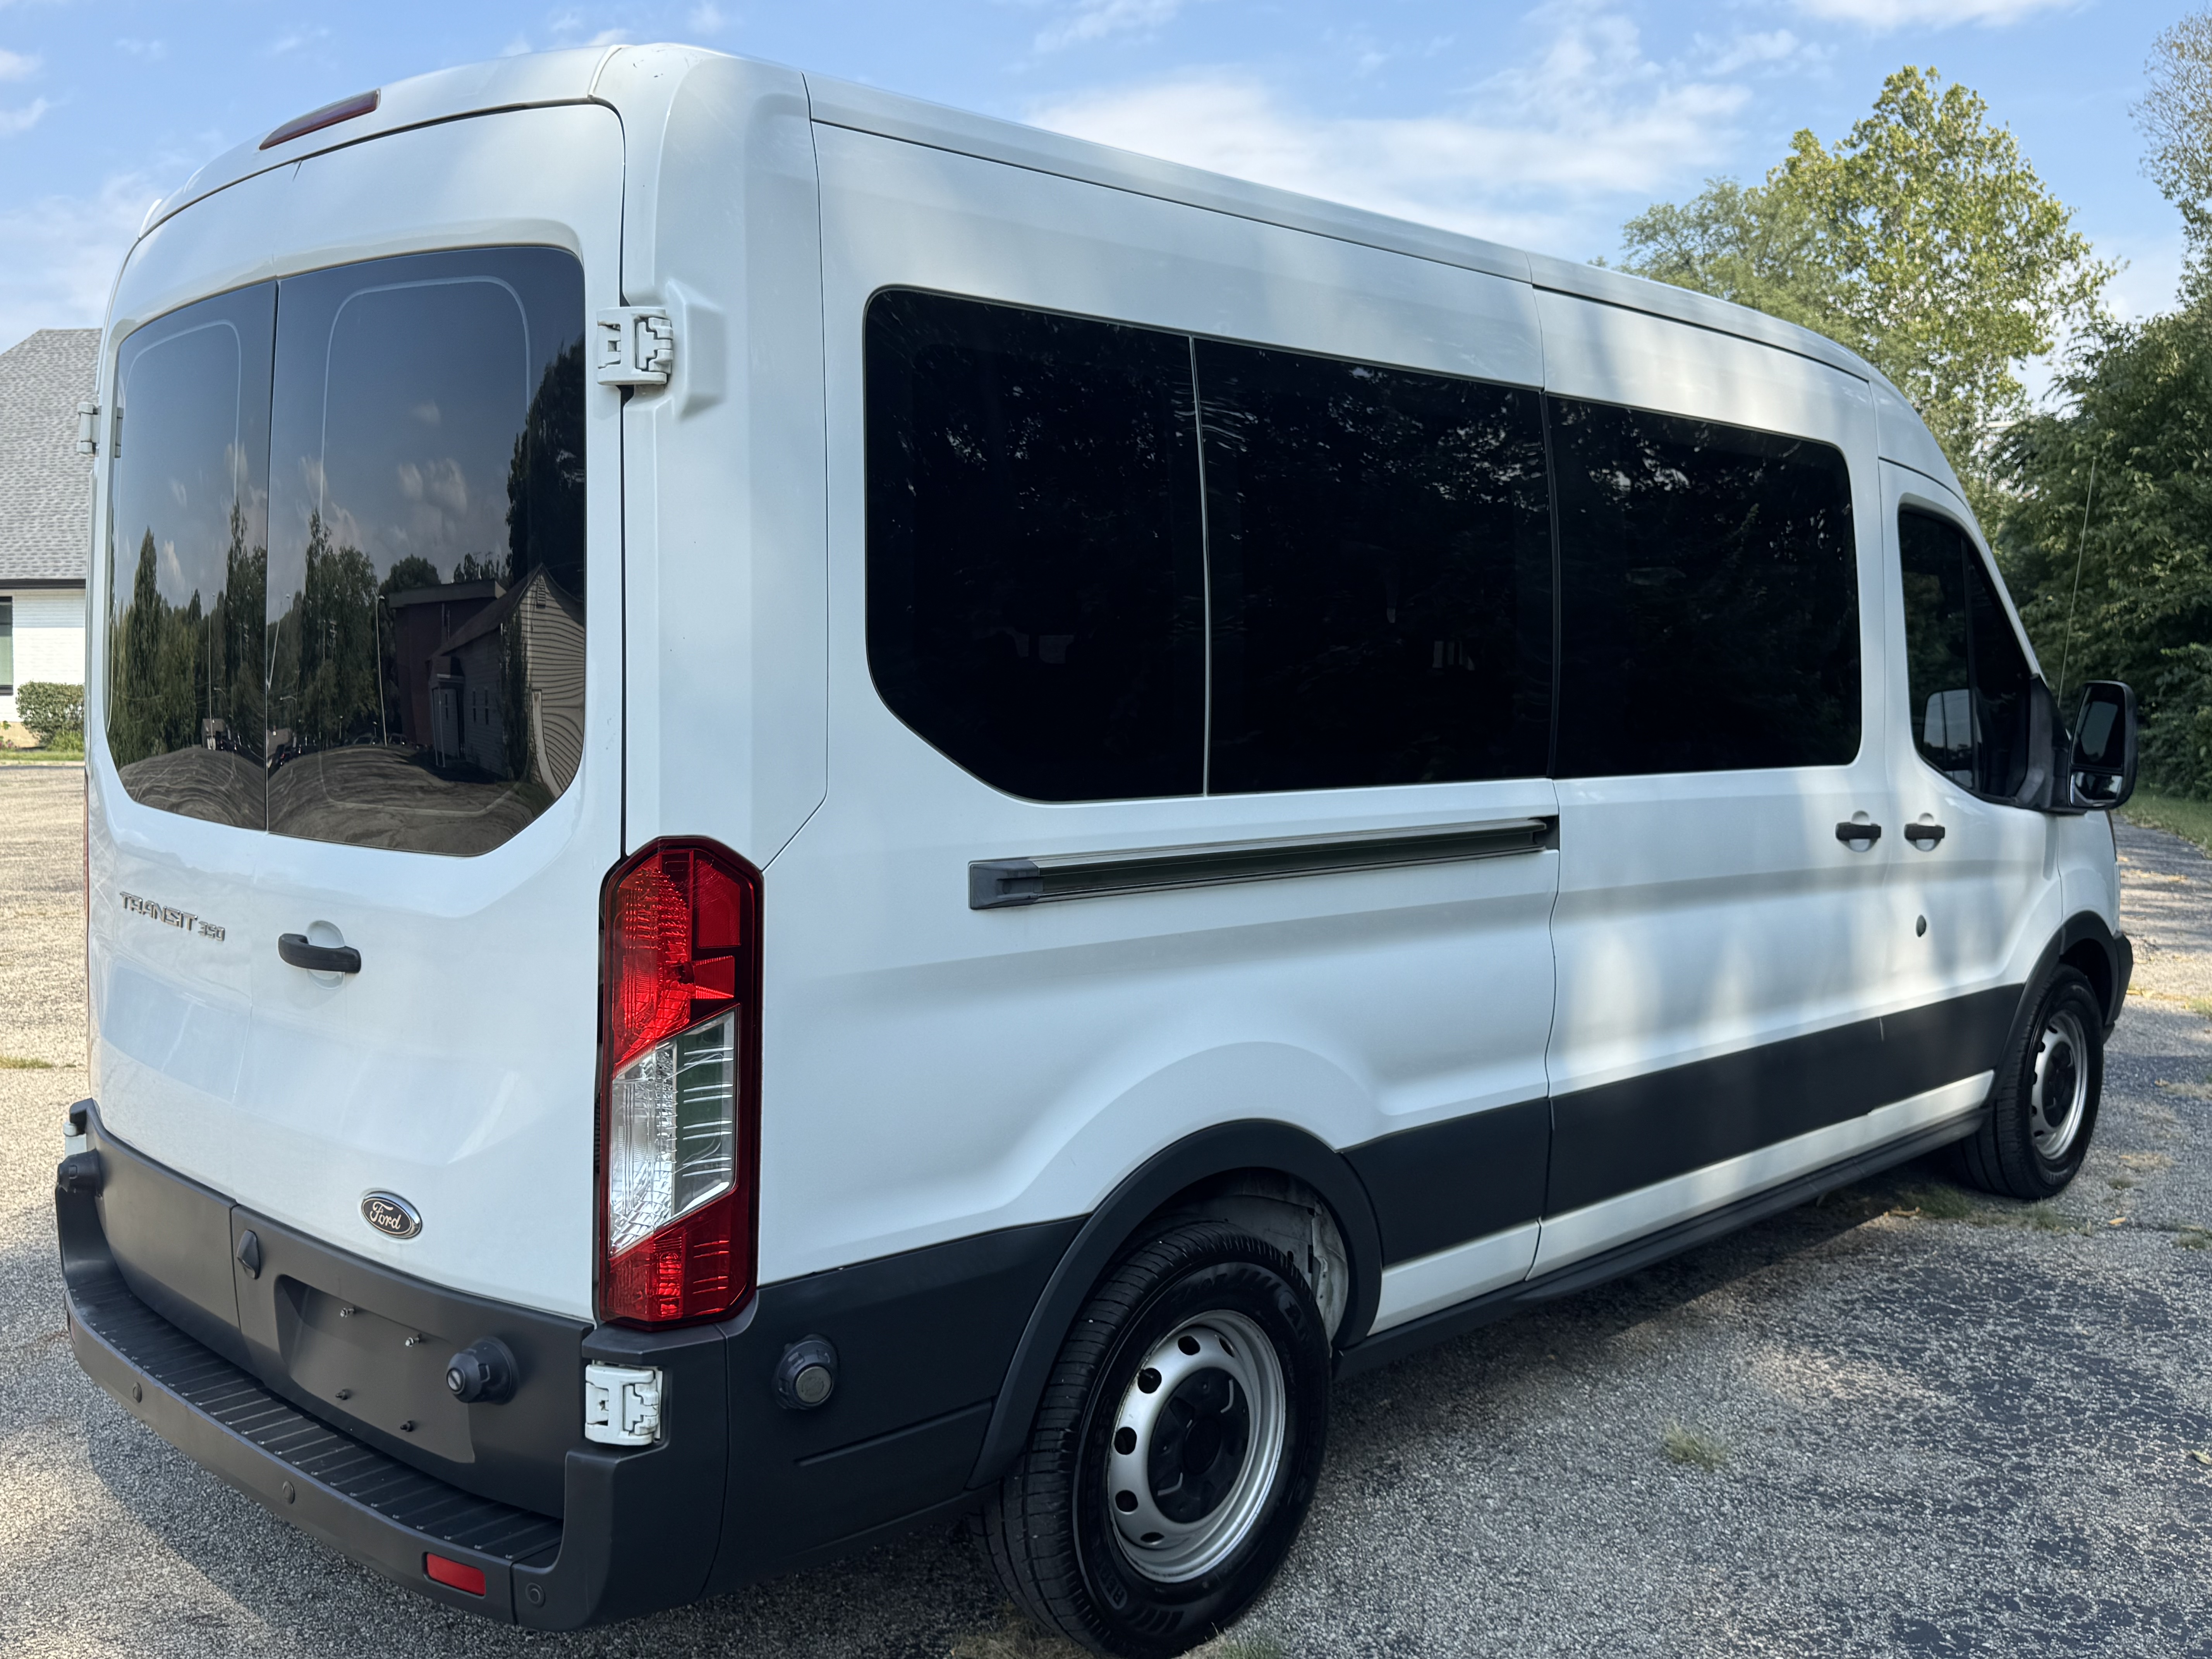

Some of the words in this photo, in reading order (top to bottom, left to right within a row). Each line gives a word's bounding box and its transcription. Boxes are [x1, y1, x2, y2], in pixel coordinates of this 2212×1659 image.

[119, 891, 198, 931] TRANSIT
[198, 921, 226, 941] 350
[369, 1201, 402, 1230] Ford
